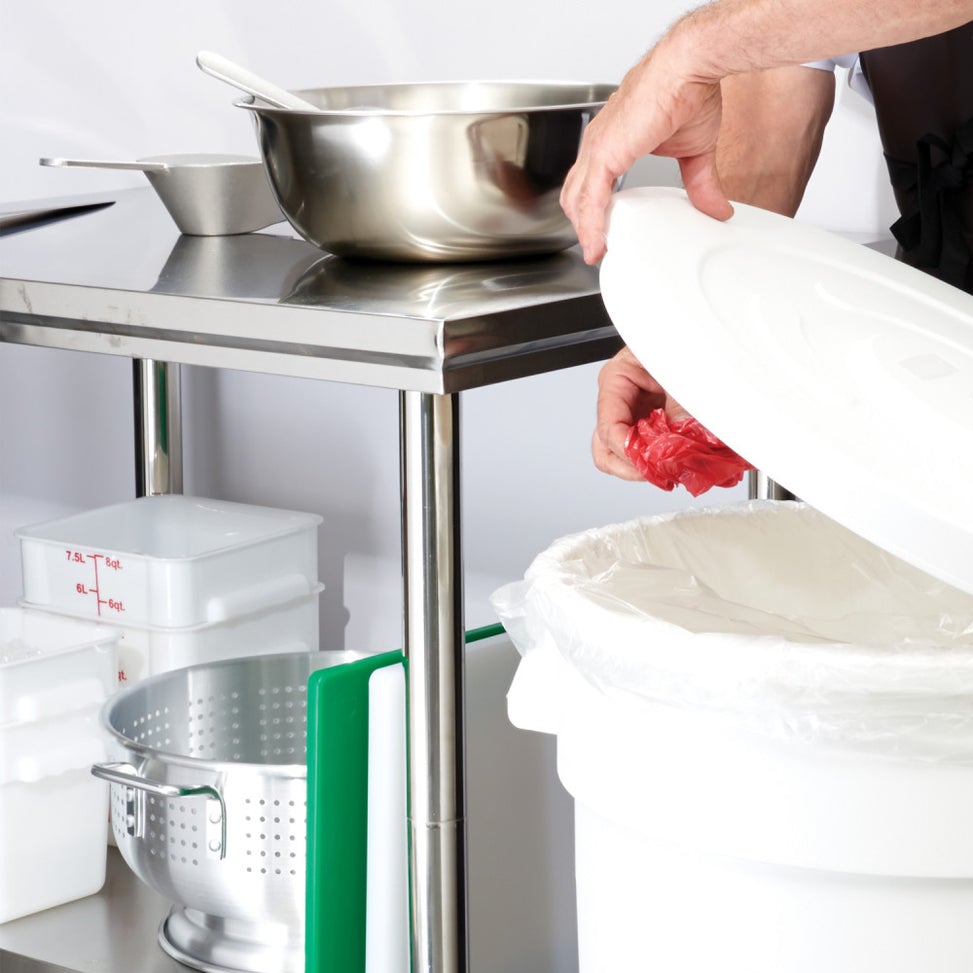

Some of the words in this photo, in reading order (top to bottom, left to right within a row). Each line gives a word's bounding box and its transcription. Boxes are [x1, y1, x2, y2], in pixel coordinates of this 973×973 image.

[66, 550, 85, 563] 7.5L
[105, 556, 123, 570] 8qt.
[76, 583, 88, 594] 6L
[108, 598, 125, 612] 6qt.
